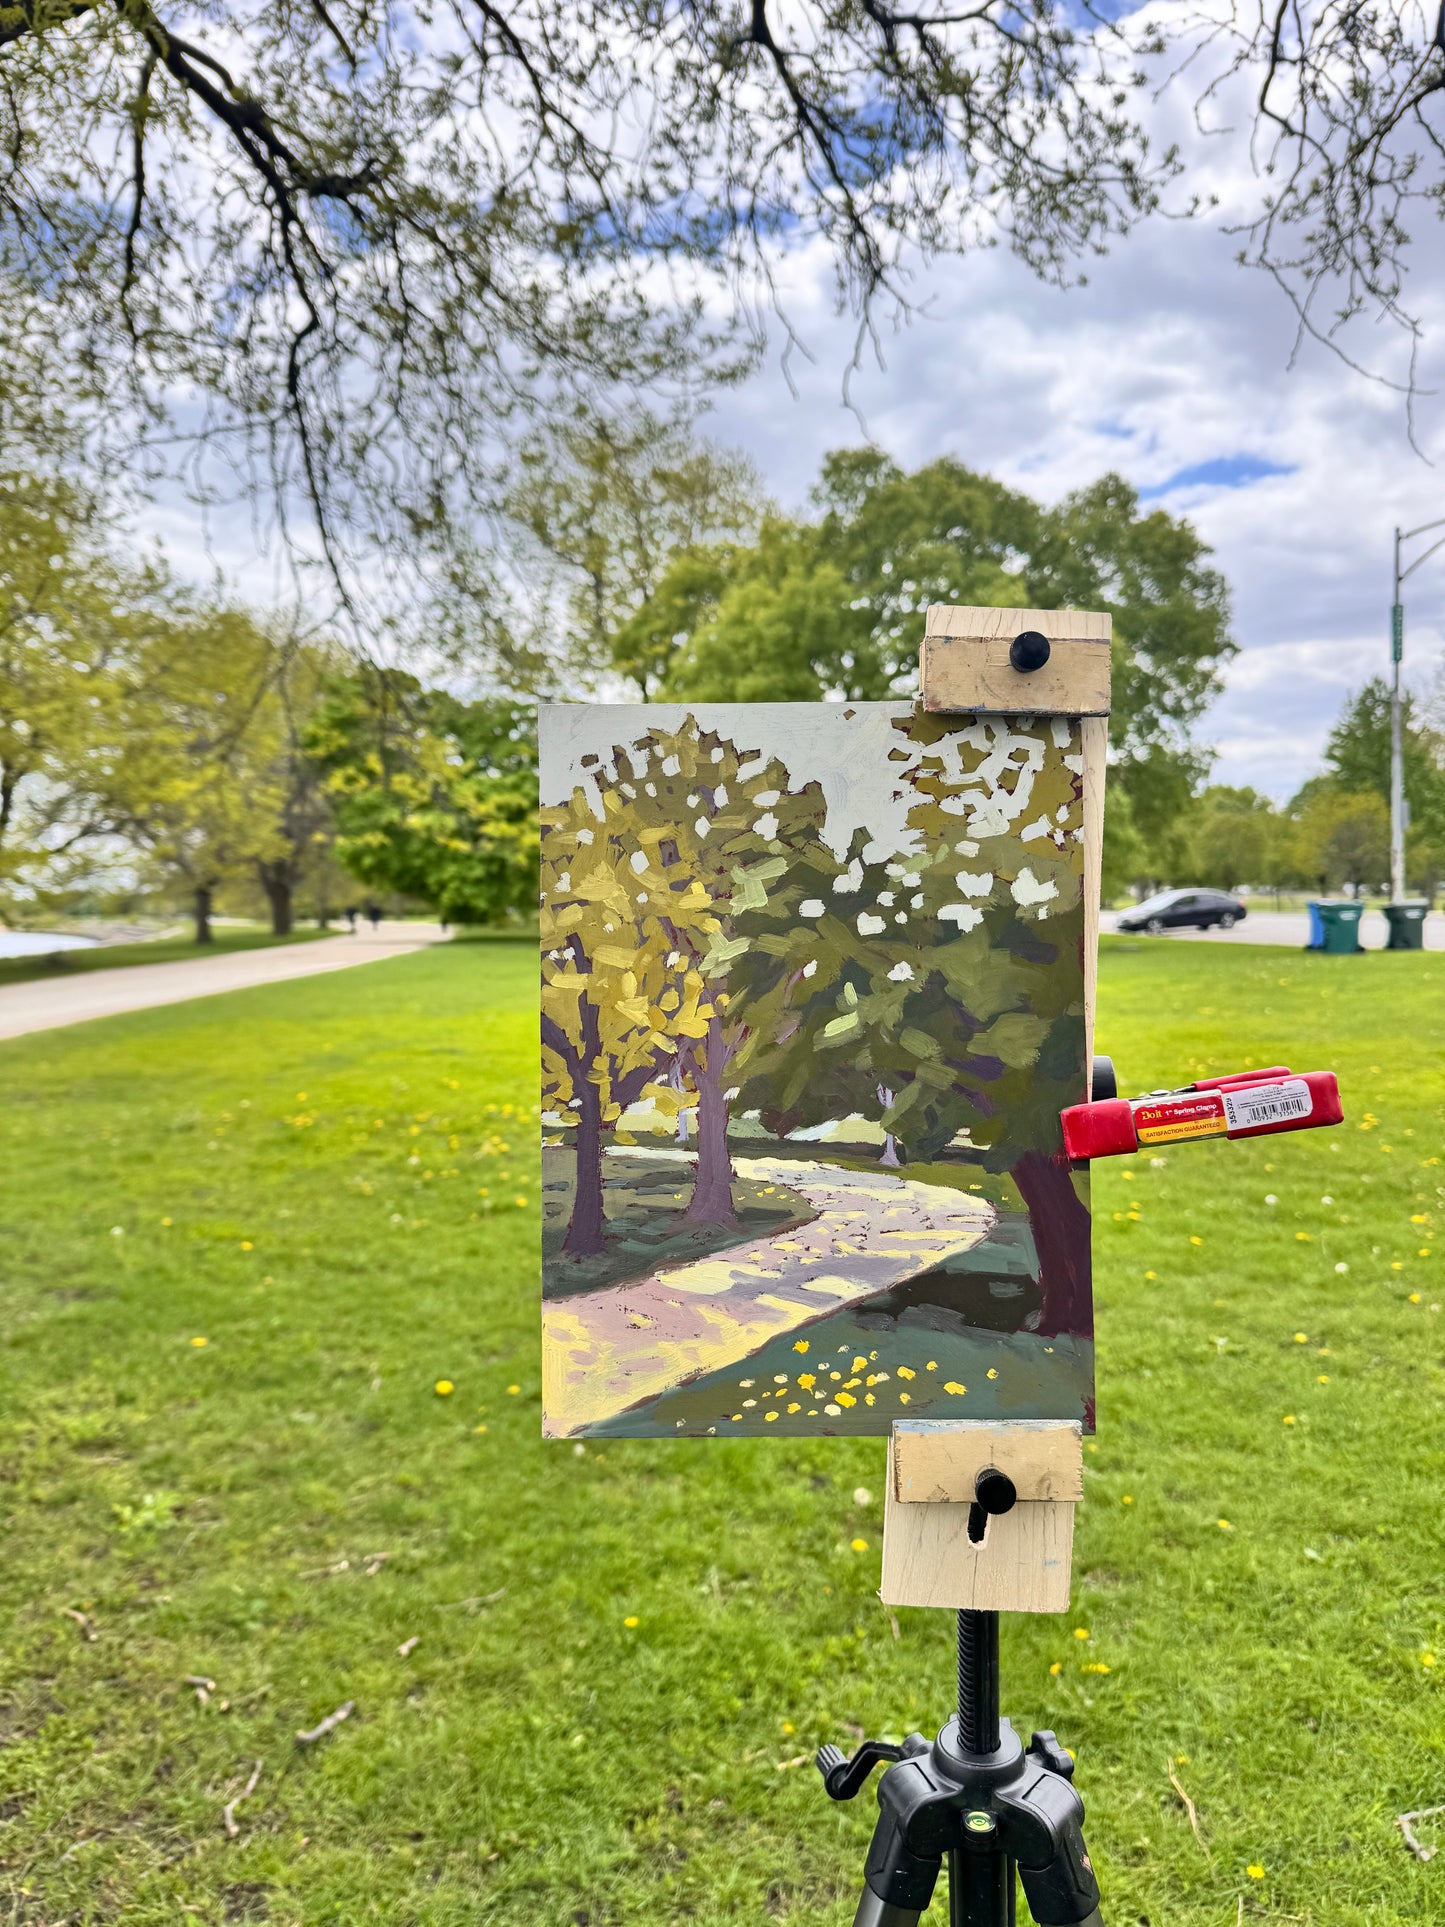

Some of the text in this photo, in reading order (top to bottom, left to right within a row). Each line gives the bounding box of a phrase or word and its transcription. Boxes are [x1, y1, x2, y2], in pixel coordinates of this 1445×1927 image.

[1173, 1106, 1195, 1116] Spring
[1195, 1104, 1217, 1112] Clamp
[1146, 1122, 1221, 1138] SATISFACTION GUARANTEED
